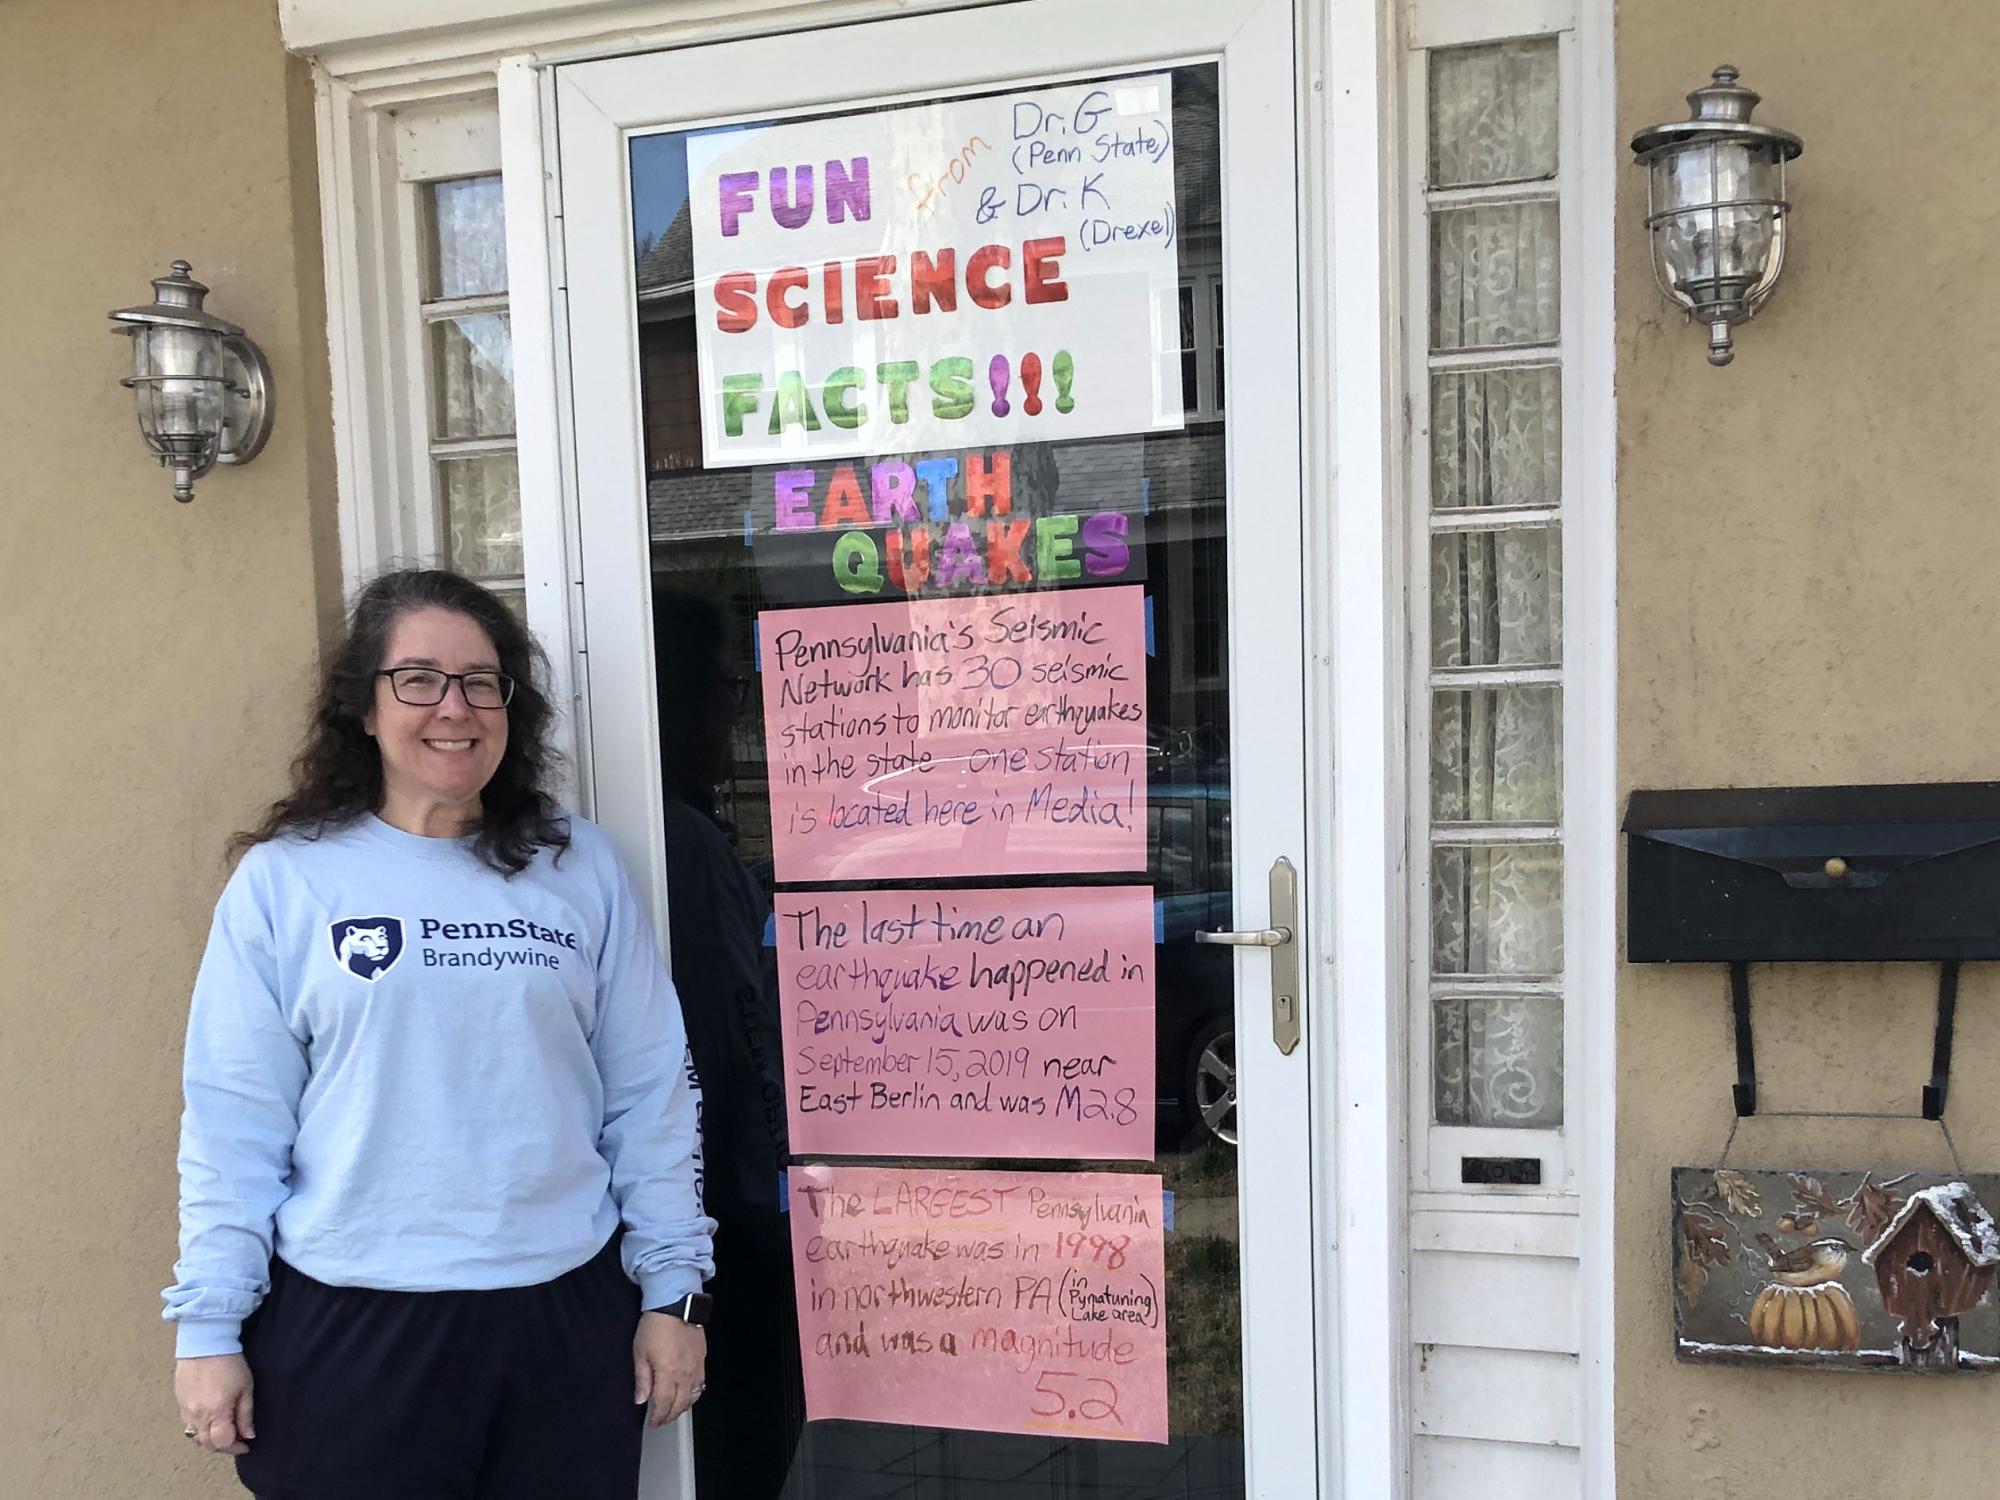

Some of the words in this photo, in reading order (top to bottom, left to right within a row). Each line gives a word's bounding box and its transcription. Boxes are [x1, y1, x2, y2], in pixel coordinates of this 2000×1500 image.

[1013, 140, 1081, 174] (Penn
[1090, 119, 1171, 163] State)
[719, 156, 871, 237] FUN
[907, 134, 992, 211] from
[976, 187, 1006, 224] &
[1080, 173, 1110, 210] K
[1080, 202, 1175, 251] (Drexel)
[713, 236, 1069, 333] SCIENCE
[722, 348, 1075, 436] FACTS!!!
[775, 451, 1012, 530] EARTH
[832, 511, 1129, 593] QUAKES
[775, 621, 974, 675] Pennsylvania's
[984, 606, 1107, 646] Seismic
[780, 670, 893, 708] Network
[902, 660, 953, 688] has
[960, 656, 1021, 690] 30
[1031, 653, 1129, 683] seismic
[781, 704, 887, 749] stations
[895, 702, 919, 734] to
[929, 695, 1020, 732] monitor
[1024, 688, 1142, 735] earthquakes
[784, 753, 807, 786] in
[812, 752, 857, 785] the
[866, 742, 934, 774] state
[968, 747, 1028, 772] one
[1039, 737, 1130, 774] station
[789, 803, 817, 834] is
[828, 794, 911, 828] located
[924, 790, 980, 824] here
[992, 790, 1015, 823] in
[1026, 778, 1135, 832] Media!
[782, 911, 850, 951] The
[862, 901, 927, 941] last
[931, 902, 1005, 944] time
[1011, 912, 1064, 941] an
[423, 947, 560, 971] Brandywine
[796, 954, 960, 1002] earthquake
[970, 948, 1110, 1000] happened
[1121, 953, 1145, 983] in
[796, 999, 962, 1043] Pennsylvania
[969, 1010, 1029, 1033] was
[1038, 1004, 1077, 1031] on
[797, 1045, 920, 1079] September
[1044, 1054, 1117, 1079] near
[799, 1082, 863, 1114] East
[870, 1082, 939, 1111] Berlin
[949, 1082, 990, 1112] and
[1000, 1093, 1045, 1114] was
[797, 1185, 865, 1219] The
[873, 1179, 1023, 1218] LARGEST
[805, 1228, 950, 1270] earthquake
[956, 1240, 1004, 1262] was
[1015, 1236, 1039, 1262] in
[1055, 1231, 1132, 1270] 1998
[810, 1278, 836, 1312] in
[843, 1275, 1001, 1311] northwestern
[1014, 1275, 1052, 1313] PA
[1069, 1285, 1152, 1316] Pymatuning
[1071, 1307, 1109, 1322] Lake
[816, 1322, 869, 1358] and
[881, 1334, 932, 1353] was
[940, 1334, 958, 1356] a
[971, 1327, 1138, 1373] magnitude
[1030, 1371, 1124, 1426] 5.2
